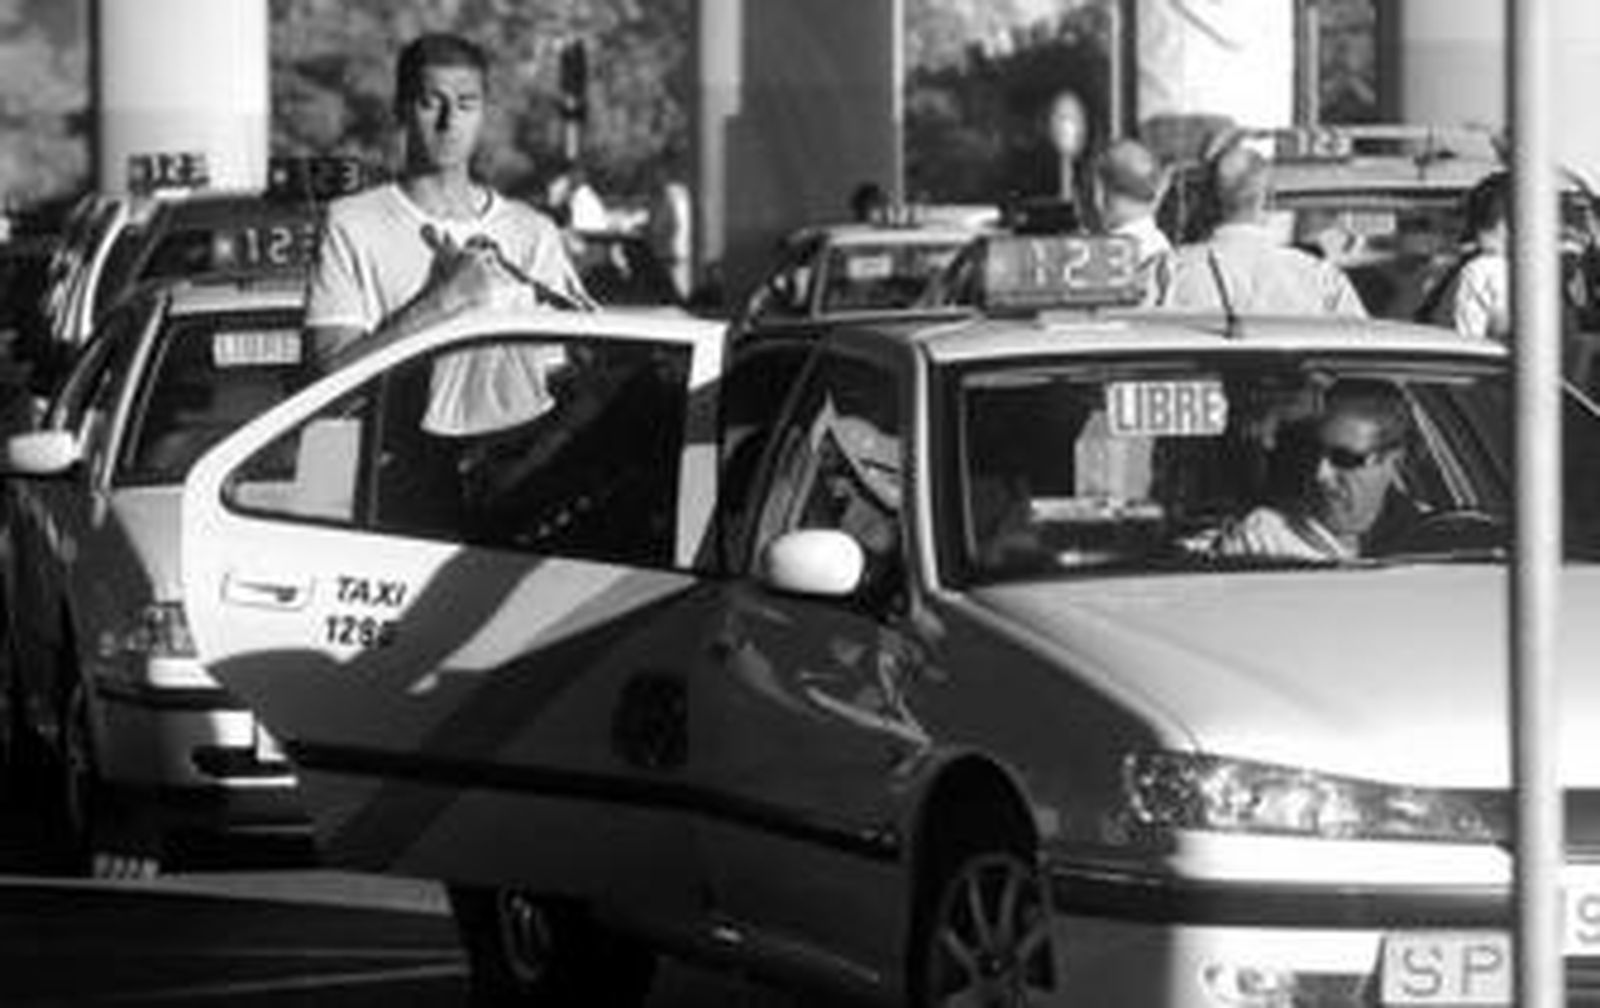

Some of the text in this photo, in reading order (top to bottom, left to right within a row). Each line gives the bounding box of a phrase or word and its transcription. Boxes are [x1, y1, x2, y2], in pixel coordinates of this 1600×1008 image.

[1031, 237, 1134, 289] 123
[1115, 385, 1225, 431] LIBRE
[337, 575, 407, 607] TAXI
[1402, 943, 1503, 997] SP
